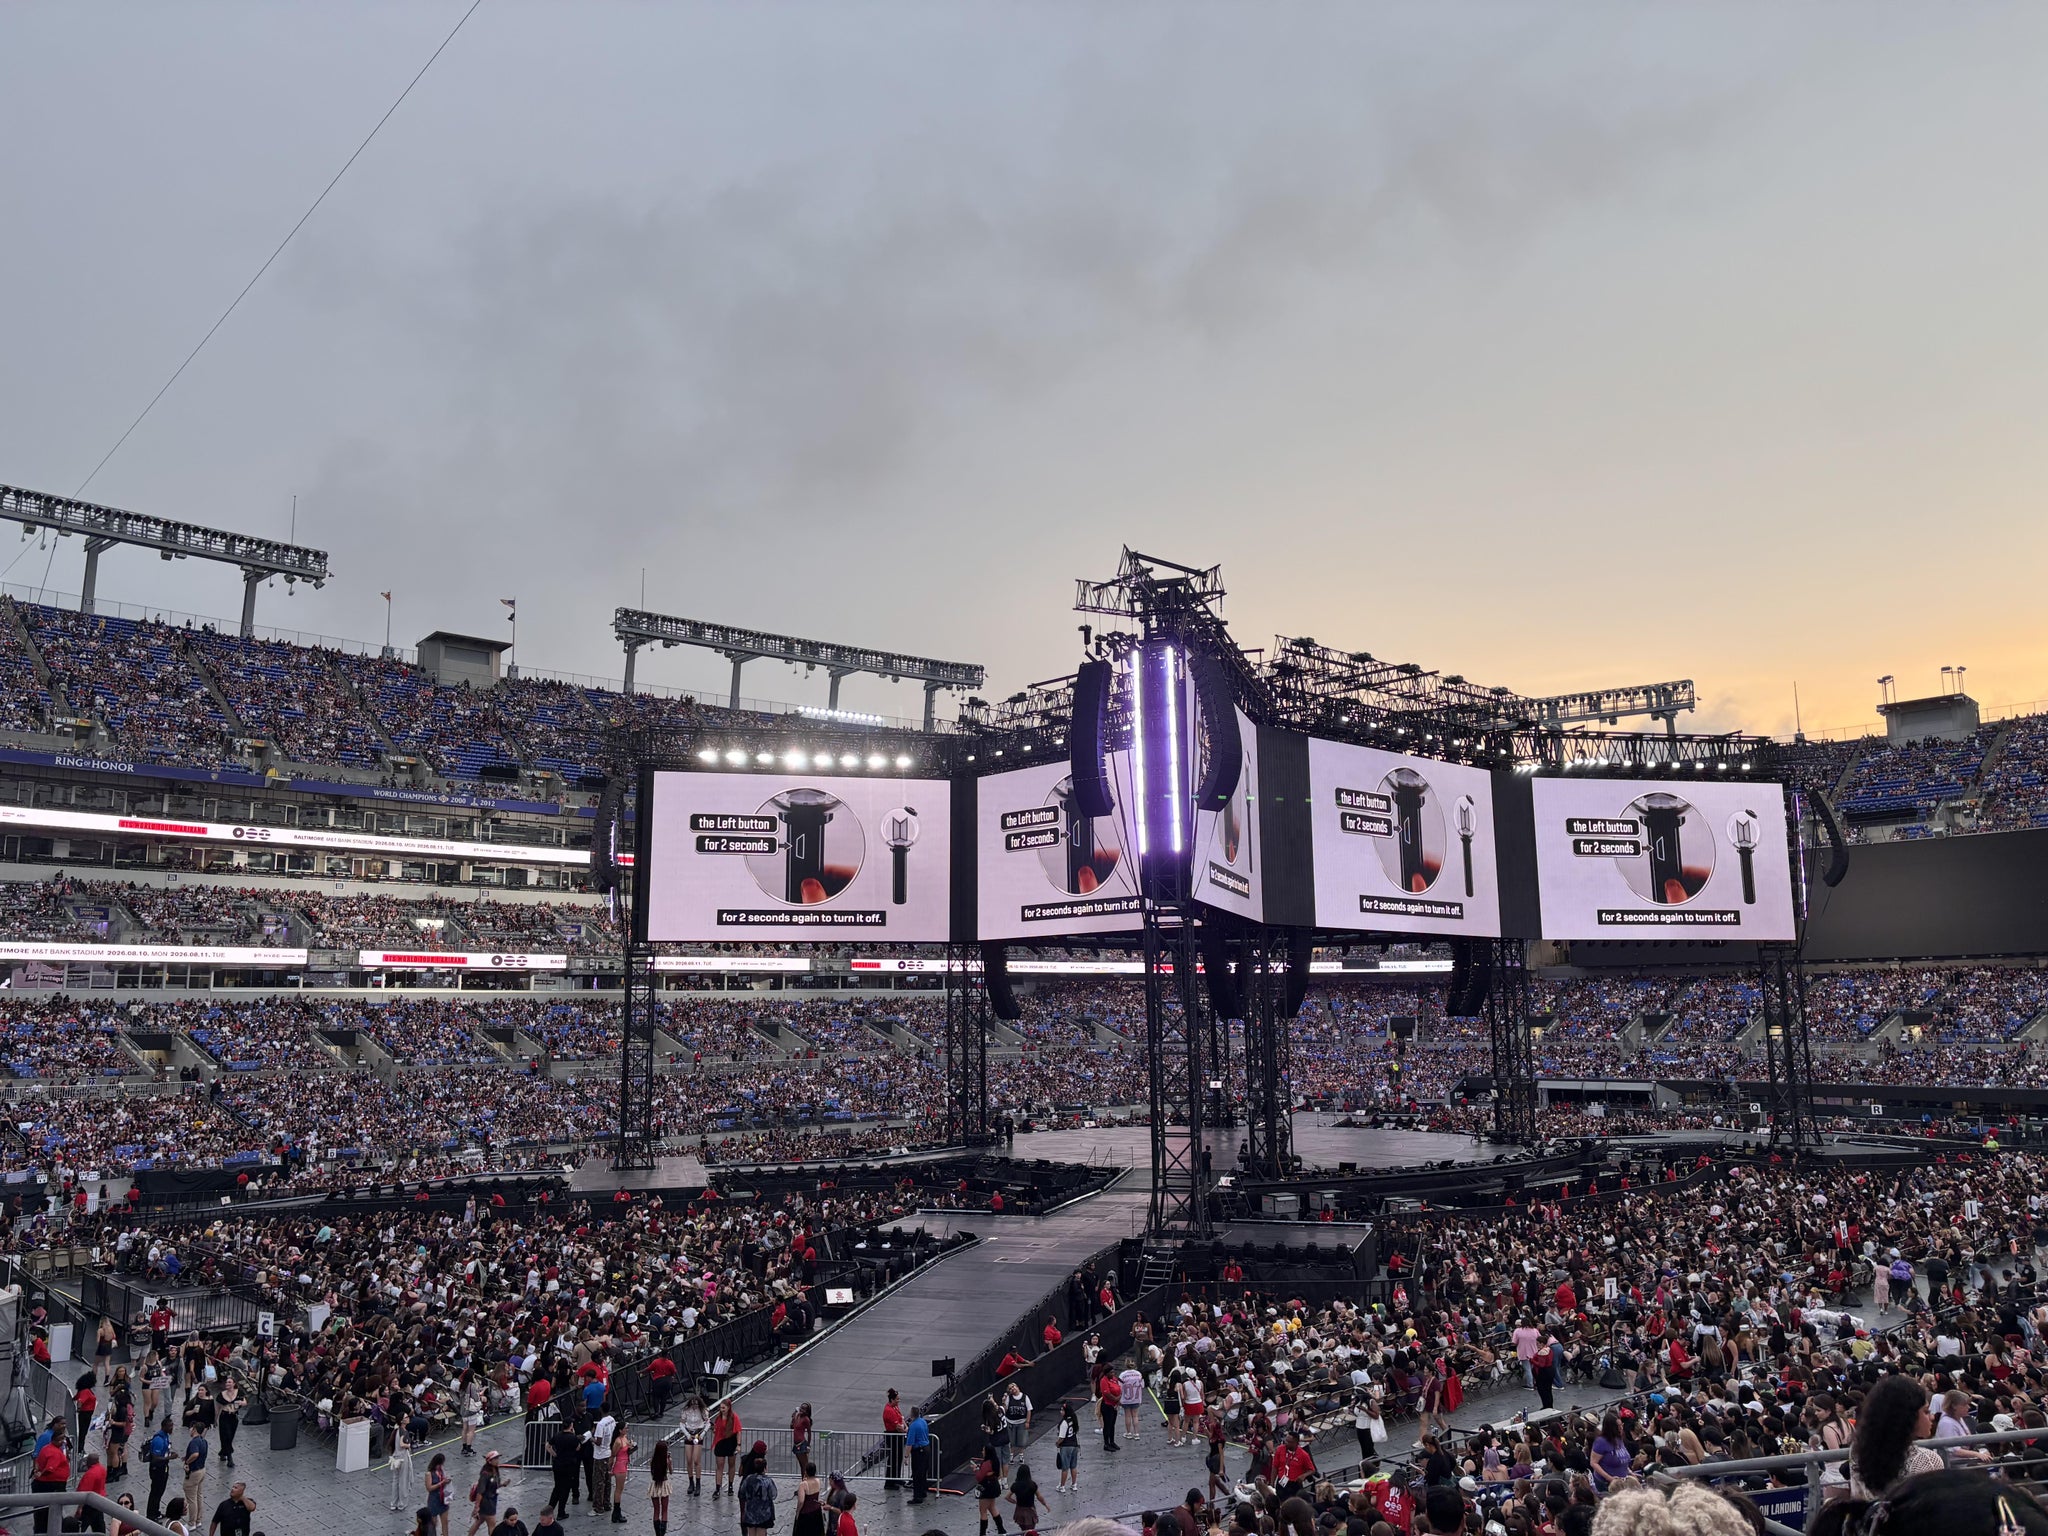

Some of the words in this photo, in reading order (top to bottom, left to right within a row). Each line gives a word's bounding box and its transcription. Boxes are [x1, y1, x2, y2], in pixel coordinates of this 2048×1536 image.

[55, 756, 83, 766] RING
[92, 760, 134, 772] HONOR
[399, 792, 437, 802] CHAMPIONS
[1341, 792, 1351, 805] the
[1353, 794, 1366, 807] Left
[1367, 795, 1387, 810] button
[699, 817, 715, 829] the
[717, 818, 736, 829] Left
[738, 818, 770, 830] button
[1006, 816, 1017, 826] the
[1018, 812, 1031, 825] Left
[1033, 810, 1054, 824] button
[1346, 816, 1356, 829] for
[1357, 817, 1361, 829] 2
[1362, 819, 1388, 833] seconds
[1574, 821, 1586, 832] the
[1588, 821, 1605, 833] Left
[1606, 822, 1633, 833] button
[705, 839, 718, 850] for
[721, 840, 727, 850] 2
[729, 840, 769, 852] seconds
[1011, 836, 1020, 848] for
[1021, 835, 1026, 846] 2
[1027, 832, 1054, 845] seconds
[1580, 842, 1592, 853] for
[1594, 842, 1599, 852] 2
[1601, 842, 1634, 853] seconds
[1025, 908, 1035, 918] for
[1036, 907, 1041, 917] 2
[1042, 905, 1072, 916] seconds
[1073, 904, 1093, 914] again
[1094, 903, 1102, 912] to
[1104, 902, 1120, 911] turn
[1122, 900, 1128, 910] it
[1363, 899, 1372, 909] for
[1374, 900, 1378, 909] 2
[1380, 900, 1406, 912] seconds
[1407, 903, 1424, 913] again
[1425, 904, 1431, 913] to
[1433, 904, 1445, 914] turn
[1446, 905, 1450, 915] it
[1451, 906, 1461, 915] off.
[722, 913, 737, 922] for
[739, 913, 746, 922] 2
[748, 913, 790, 923] seconds
[792, 914, 820, 924] again
[821, 914, 832, 923] to
[834, 914, 854, 923] turn
[856, 913, 864, 923] it
[865, 914, 882, 923] off.
[1602, 912, 1614, 921] for
[1616, 913, 1622, 921] 2
[1623, 913, 1658, 922] seconds
[1660, 913, 1683, 923] again
[1685, 914, 1694, 922] to
[1695, 914, 1713, 922] turn
[1715, 913, 1721, 922] it
[1722, 913, 1736, 922] off.
[1873, 1106, 1880, 1114] R
[1970, 1203, 1976, 1217] L
[262, 1321, 270, 1333] C
[1771, 1501, 1801, 1515] LANDING
